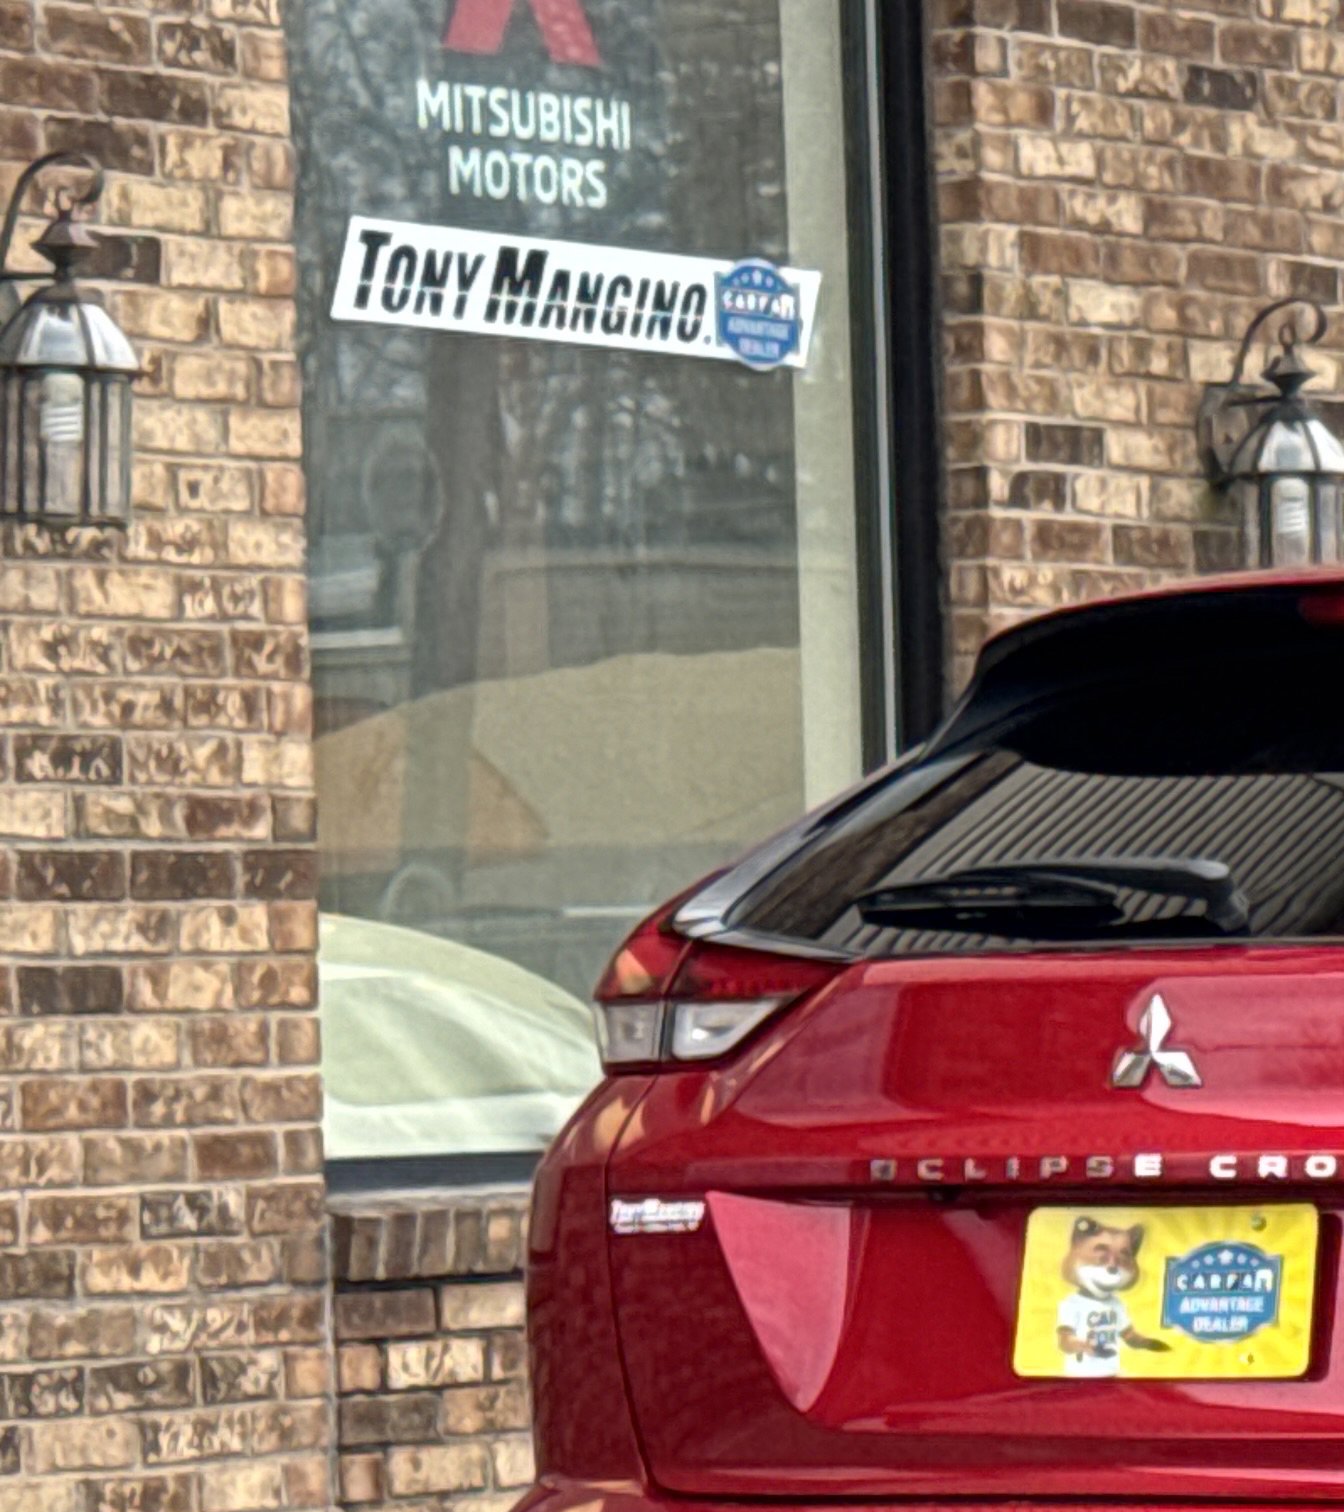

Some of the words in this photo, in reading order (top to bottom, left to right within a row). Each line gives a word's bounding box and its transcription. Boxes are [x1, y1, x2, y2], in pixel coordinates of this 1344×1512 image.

[416, 79, 631, 150] MITSUBISHI
[449, 146, 608, 209] MOTORS
[354, 229, 486, 320] TONY
[868, 1152, 1163, 1181] ECLIPSE
[1087, 1310, 1118, 1329] CAR
[1179, 1296, 1265, 1314] ADVANTAGE
[1192, 1314, 1249, 1333] DEALER
